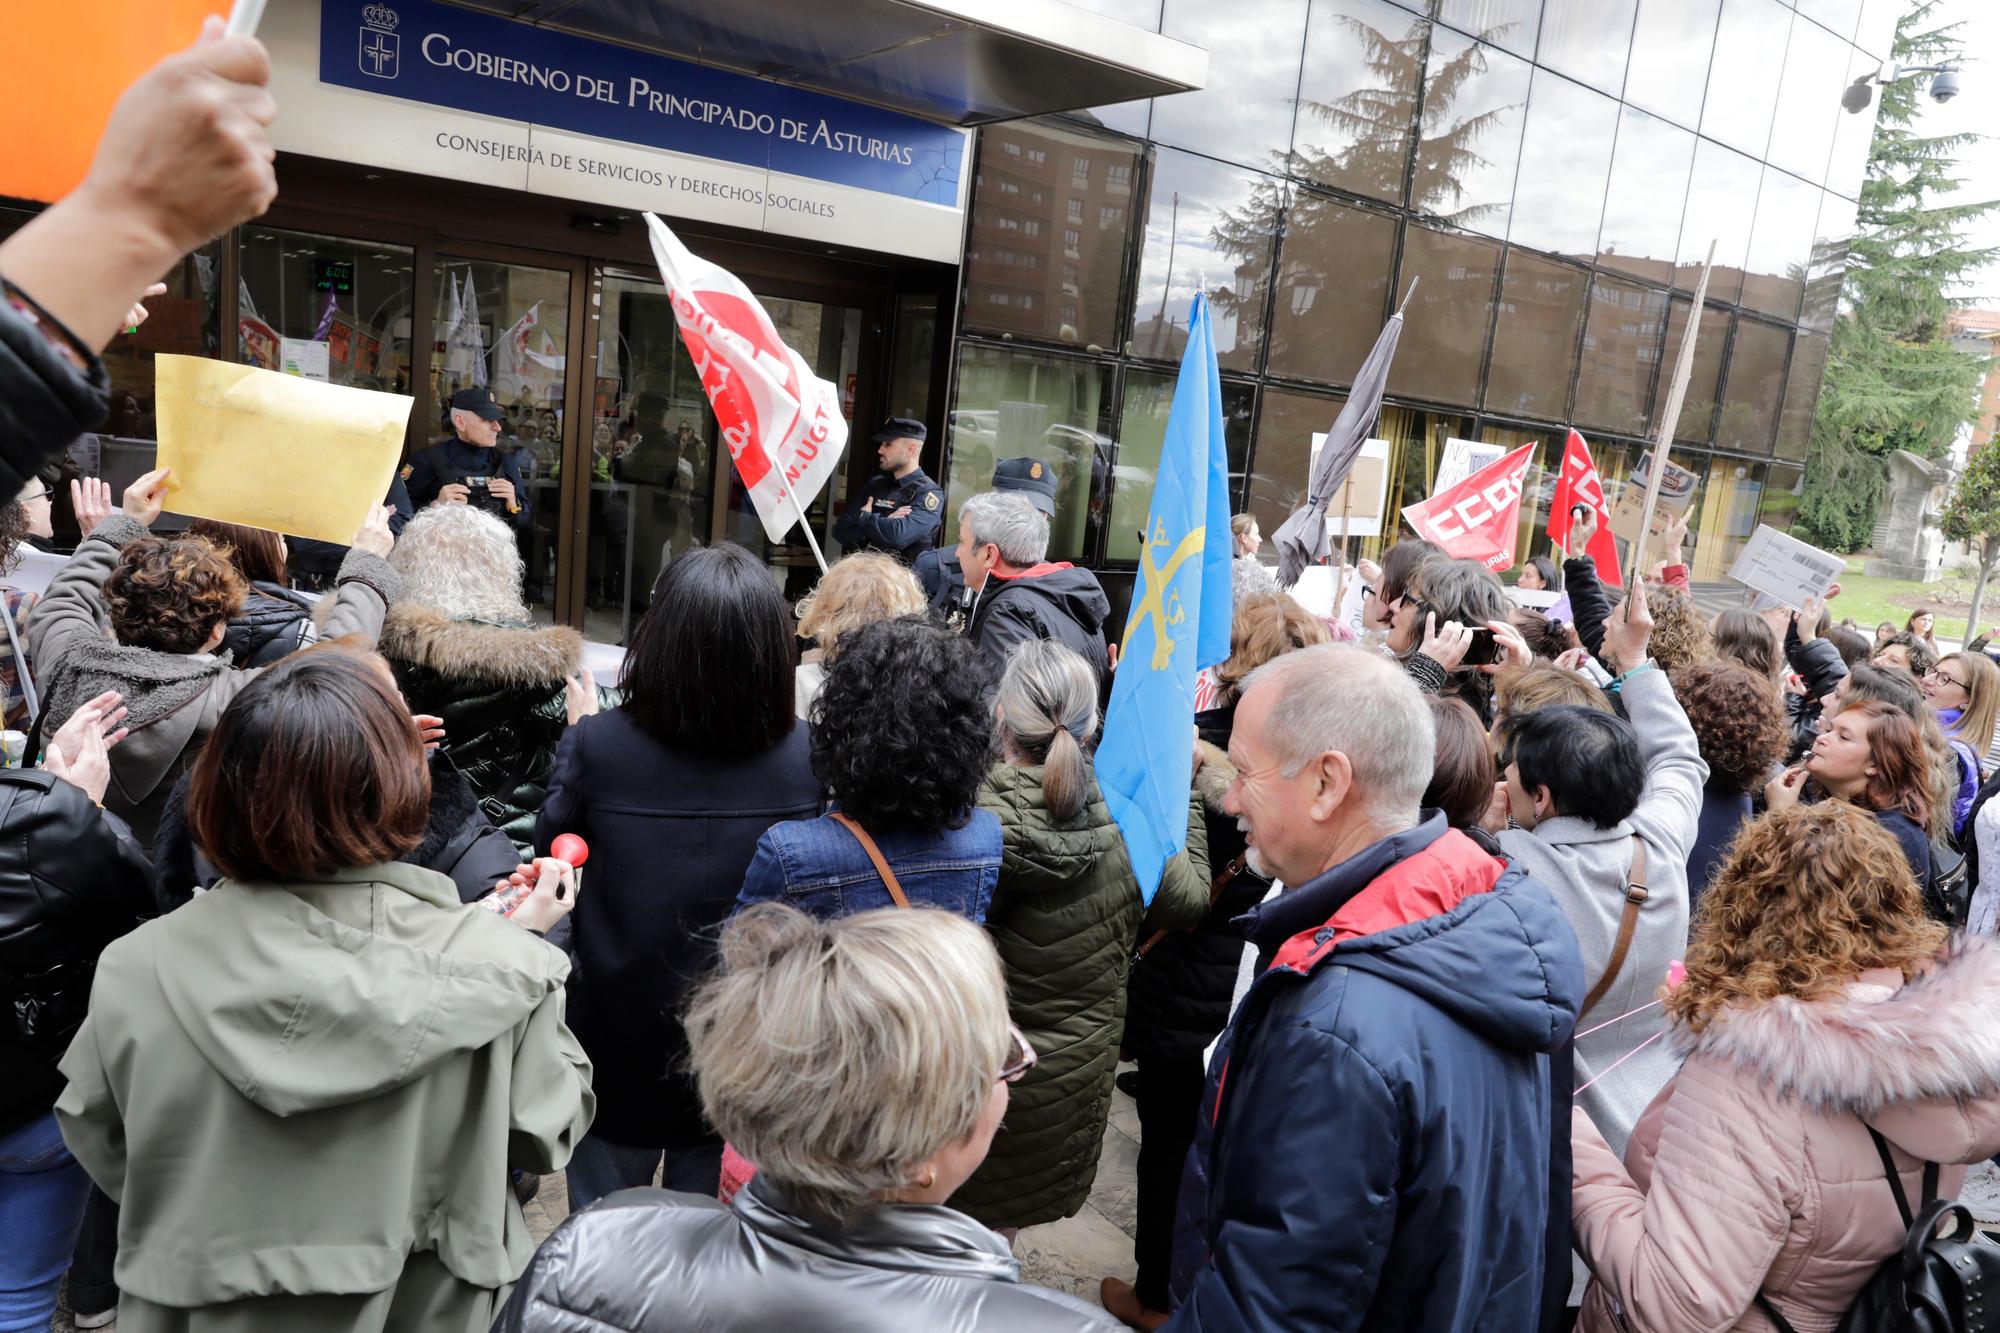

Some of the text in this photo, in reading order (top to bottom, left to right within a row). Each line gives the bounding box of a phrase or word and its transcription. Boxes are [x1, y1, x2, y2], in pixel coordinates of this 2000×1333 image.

[421, 32, 913, 166] GOBIERNO DEL PRINCIPADO DE ASTURIAS
[436, 132, 835, 218] CONSEJERÍA DE SERVICIOS Y DERECHOS SOCIALES
[1483, 549, 1510, 569] URIAS
